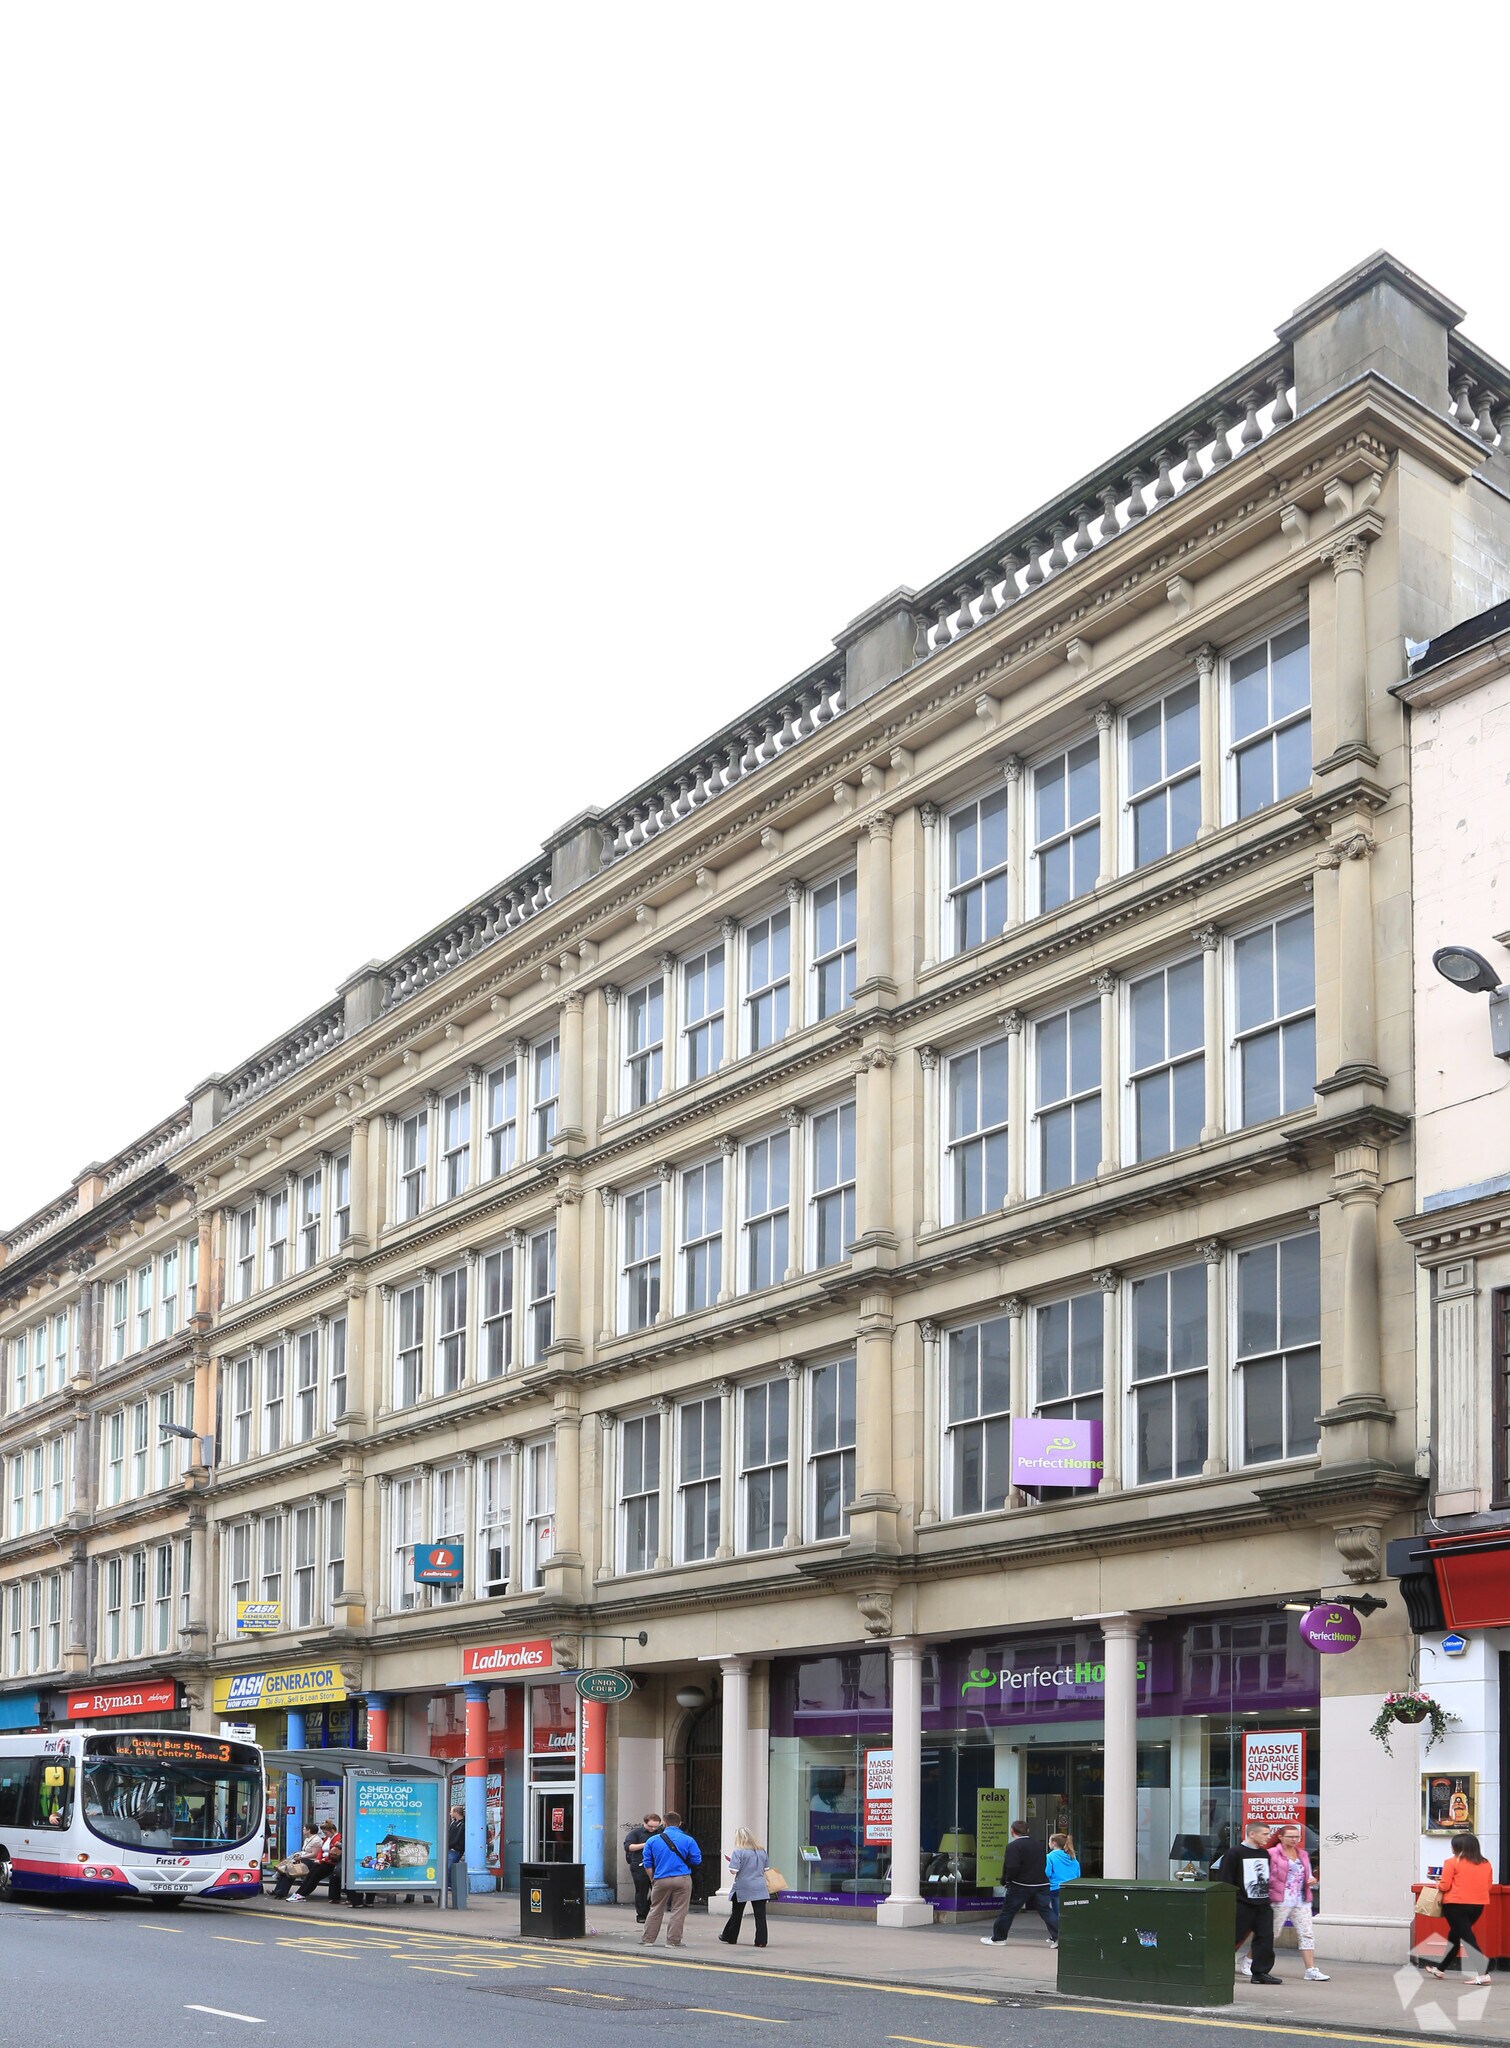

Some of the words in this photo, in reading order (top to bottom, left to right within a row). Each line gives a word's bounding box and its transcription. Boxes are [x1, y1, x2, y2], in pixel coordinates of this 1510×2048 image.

[1018, 1457, 1103, 1468] PerfectHome
[436, 1552, 446, 1564] L
[246, 1605, 277, 1613] CASH
[1310, 1631, 1356, 1641] PerfectHome
[472, 1647, 543, 1670] Ladbrokes
[1000, 1661, 1146, 1689] PerfectHoe
[230, 1675, 264, 1697] CASH
[266, 1670, 333, 1692] GENERATOR
[320, 1692, 334, 1701] Store
[93, 1694, 143, 1711] Ryman
[227, 1700, 241, 1708] NOW
[44, 1740, 57, 1752] First
[132, 1739, 162, 1748] Govan
[165, 1741, 181, 1749] Bus
[184, 1742, 203, 1751] Stn.
[1249, 1744, 1299, 1755] MASSIVE
[135, 1747, 155, 1757] City
[157, 1748, 193, 1758] Centre,
[219, 1744, 231, 1762] 3
[1248, 1755, 1299, 1763] CLEARANCE
[1248, 1764, 1269, 1772] AND
[1271, 1763, 1299, 1771] HUGE
[1248, 1771, 1299, 1782] SAVINGS
[390, 1786, 413, 1794] LOAD
[981, 1792, 1006, 1802] relax
[1266, 1812, 1300, 1820] QUALITY
